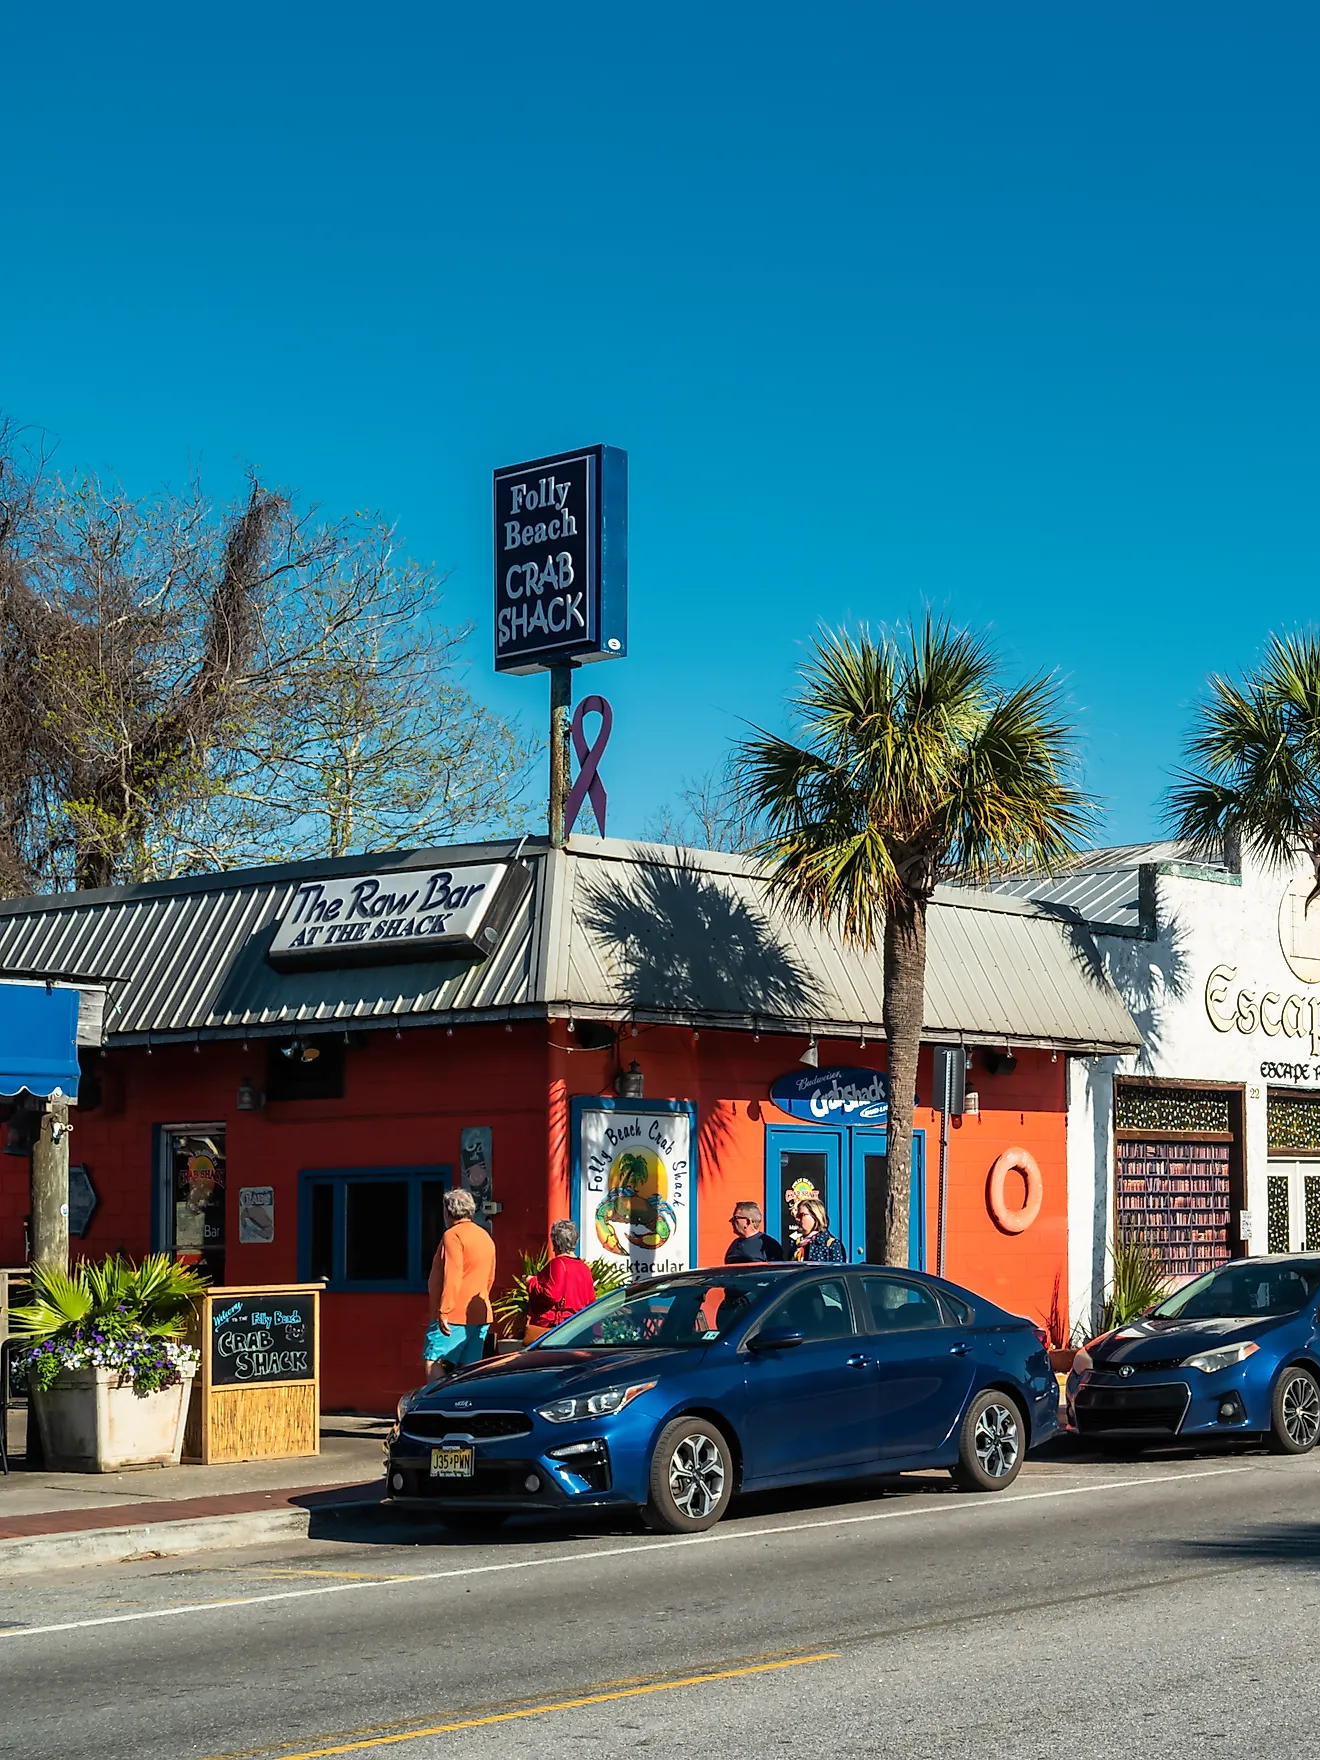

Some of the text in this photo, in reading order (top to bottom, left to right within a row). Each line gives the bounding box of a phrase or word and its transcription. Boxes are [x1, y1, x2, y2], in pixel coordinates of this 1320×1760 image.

[510, 476, 571, 515] Folly
[504, 508, 577, 550] Beach
[506, 551, 574, 599] CRAB
[498, 592, 585, 647] SHACK
[291, 872, 486, 924] The Raw Bar
[288, 913, 453, 948] AT THE SHACK
[796, 1071, 842, 1091] Budweiser
[1260, 1062, 1310, 1083] ESCAPE
[1250, 1088, 1260, 1099] 22
[588, 1118, 688, 1208] Folly Beach Crab Shack
[204, 1225, 220, 1238] Bar
[251, 1312, 272, 1329] Folly
[274, 1310, 302, 1326] Beach
[218, 1330, 274, 1357] CRAB
[234, 1351, 307, 1379] SHACK
